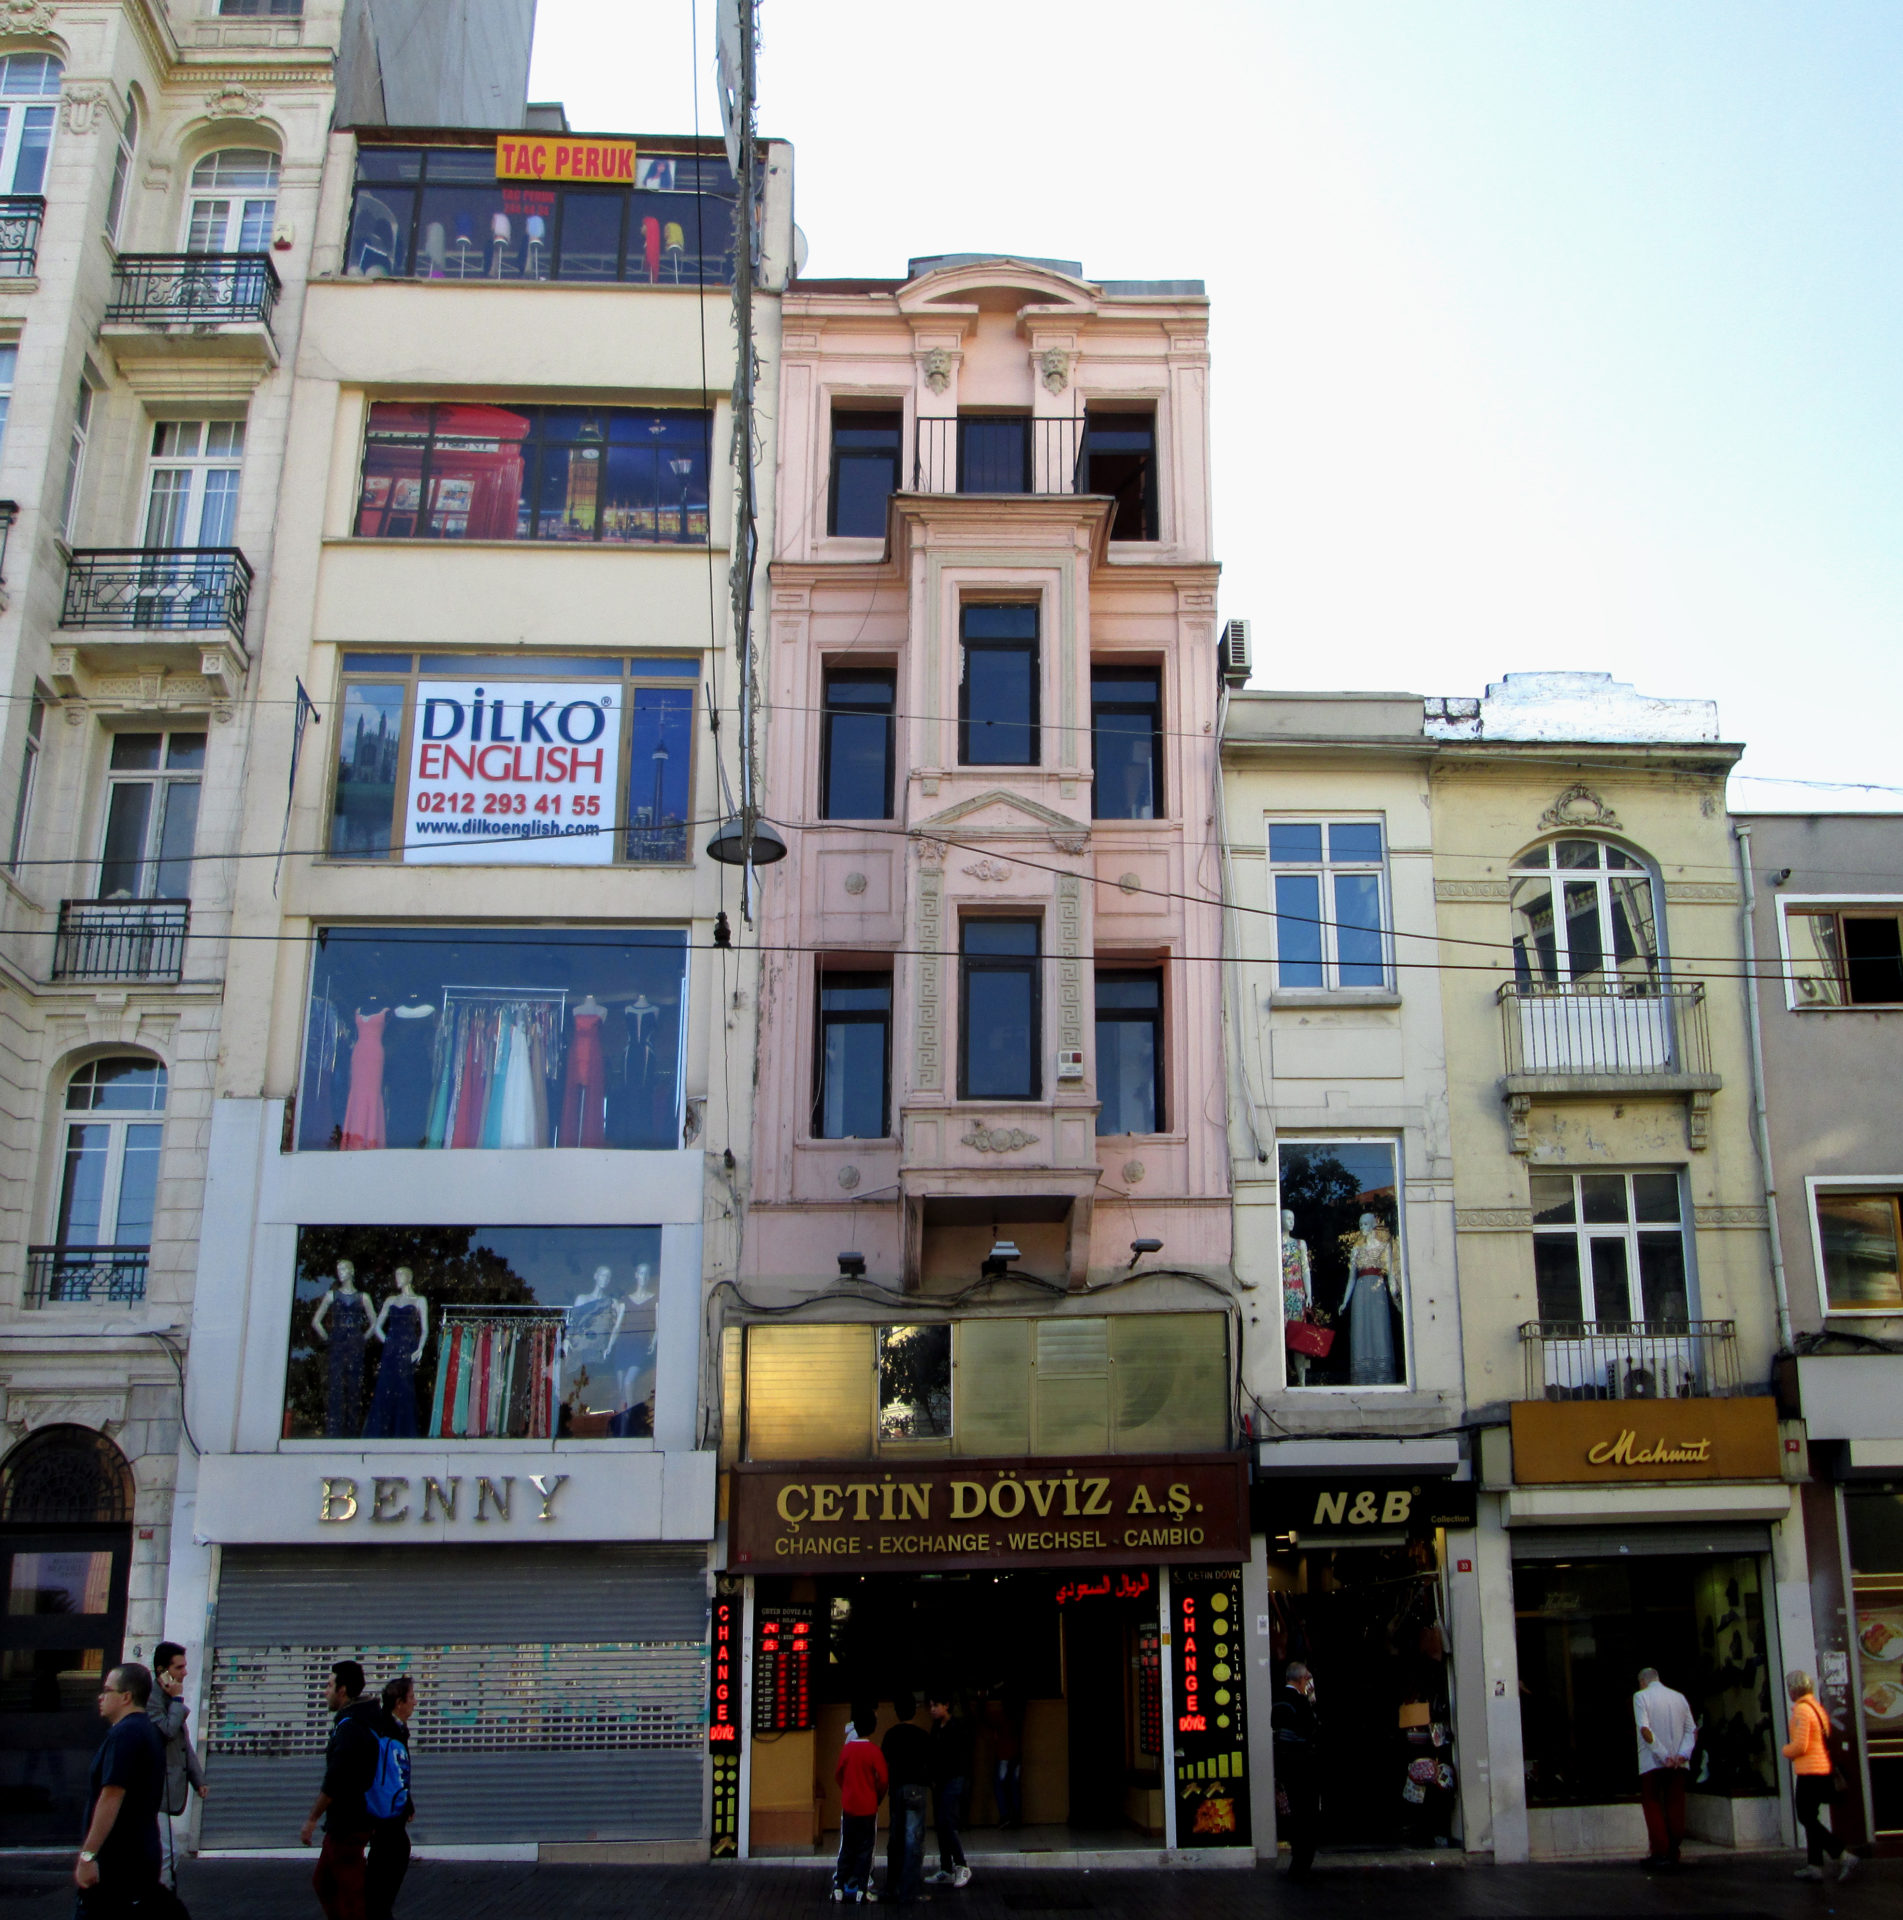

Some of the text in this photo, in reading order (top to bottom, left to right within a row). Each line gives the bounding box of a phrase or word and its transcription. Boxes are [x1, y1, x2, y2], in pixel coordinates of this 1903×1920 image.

[502, 143, 634, 180] TAÇ PERUK
[419, 744, 604, 784] ENGLISH
[416, 791, 601, 817] 0212 293 41 55
[416, 819, 600, 840] www.dilkoenglish.com
[1588, 1428, 1712, 1465] Mahmut
[318, 1474, 570, 1522] BENNY
[776, 1468, 1204, 1532] ÇETİN DÖVİZ A.Ş.
[1312, 1490, 1413, 1525] N&B
[1430, 1513, 1471, 1524] Collection
[774, 1537, 861, 1556] CHANGE
[879, 1533, 990, 1553] EXCHANGE
[1008, 1531, 1107, 1551] WECHSEL
[1124, 1527, 1204, 1548] CAMBIO
[715, 1605, 733, 1721] CHANGE
[1182, 1597, 1199, 1712] CHANGE
[709, 1724, 735, 1741] DÖVİZ
[1178, 1714, 1207, 1732] DÖVİZ
